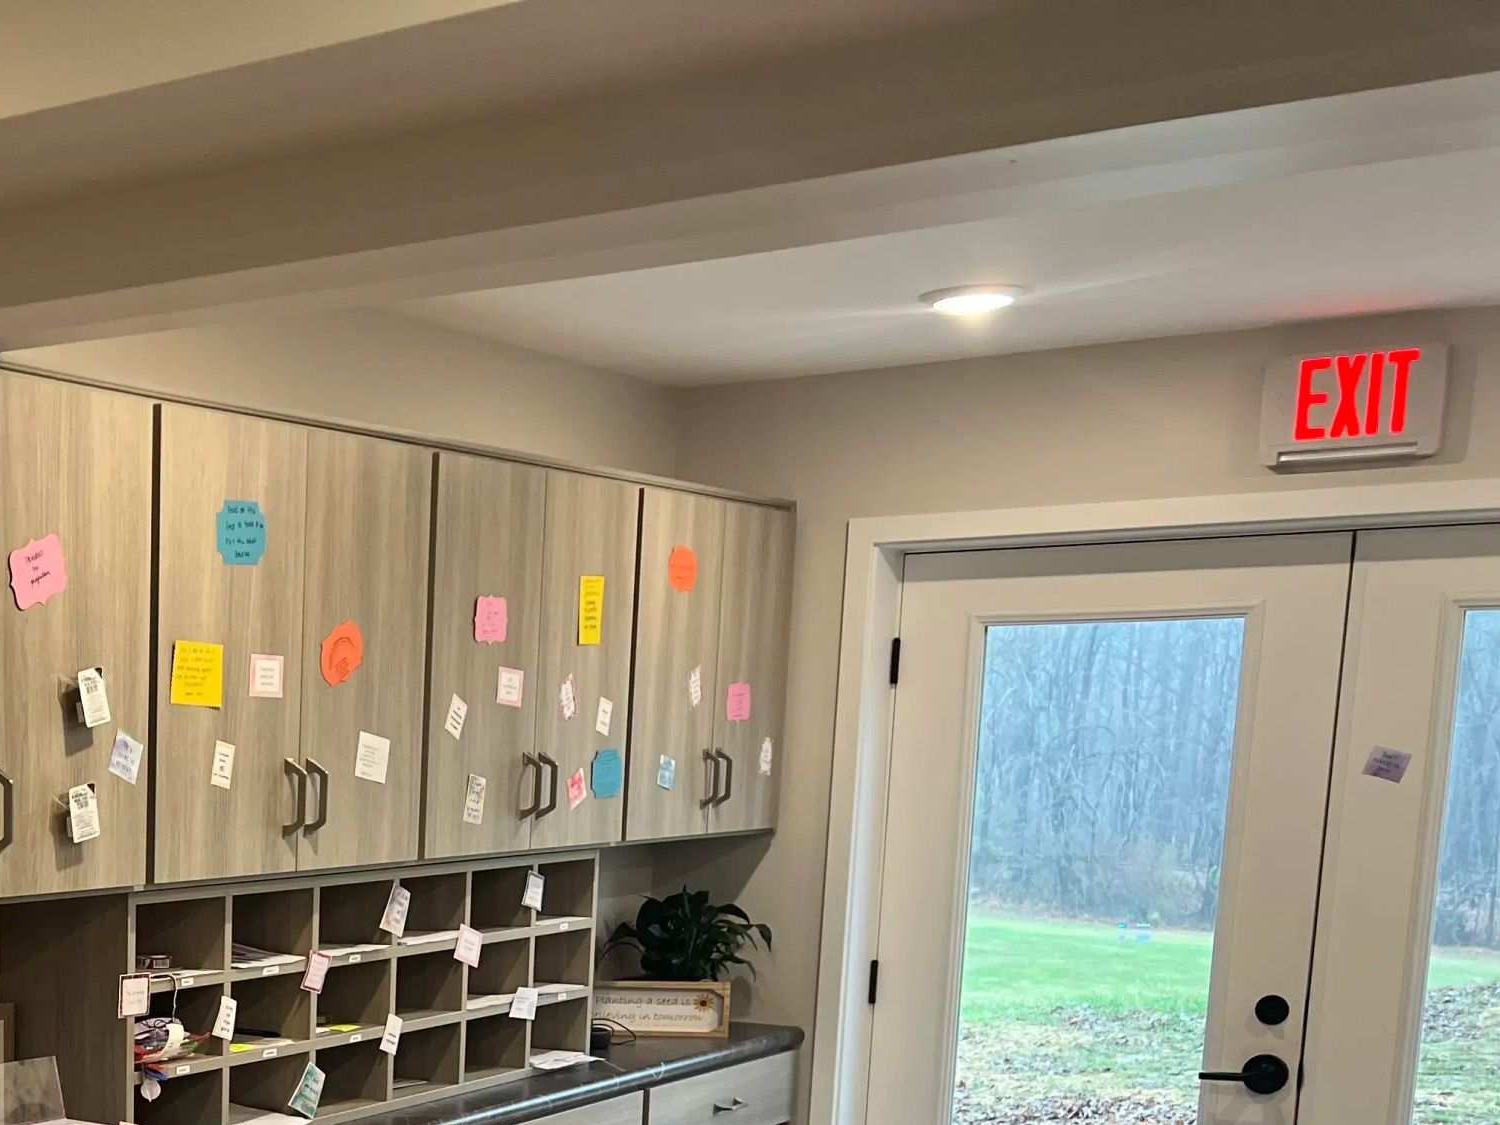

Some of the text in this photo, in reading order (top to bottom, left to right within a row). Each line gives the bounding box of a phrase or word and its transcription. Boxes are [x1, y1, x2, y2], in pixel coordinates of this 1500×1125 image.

[1294, 348, 1421, 442] EXIT
[595, 995, 643, 1009] Planting
[656, 996, 678, 1006] seed
[681, 995, 691, 1006] is
[592, 1010, 636, 1023] elieving
[654, 1012, 704, 1021] tomorrow
